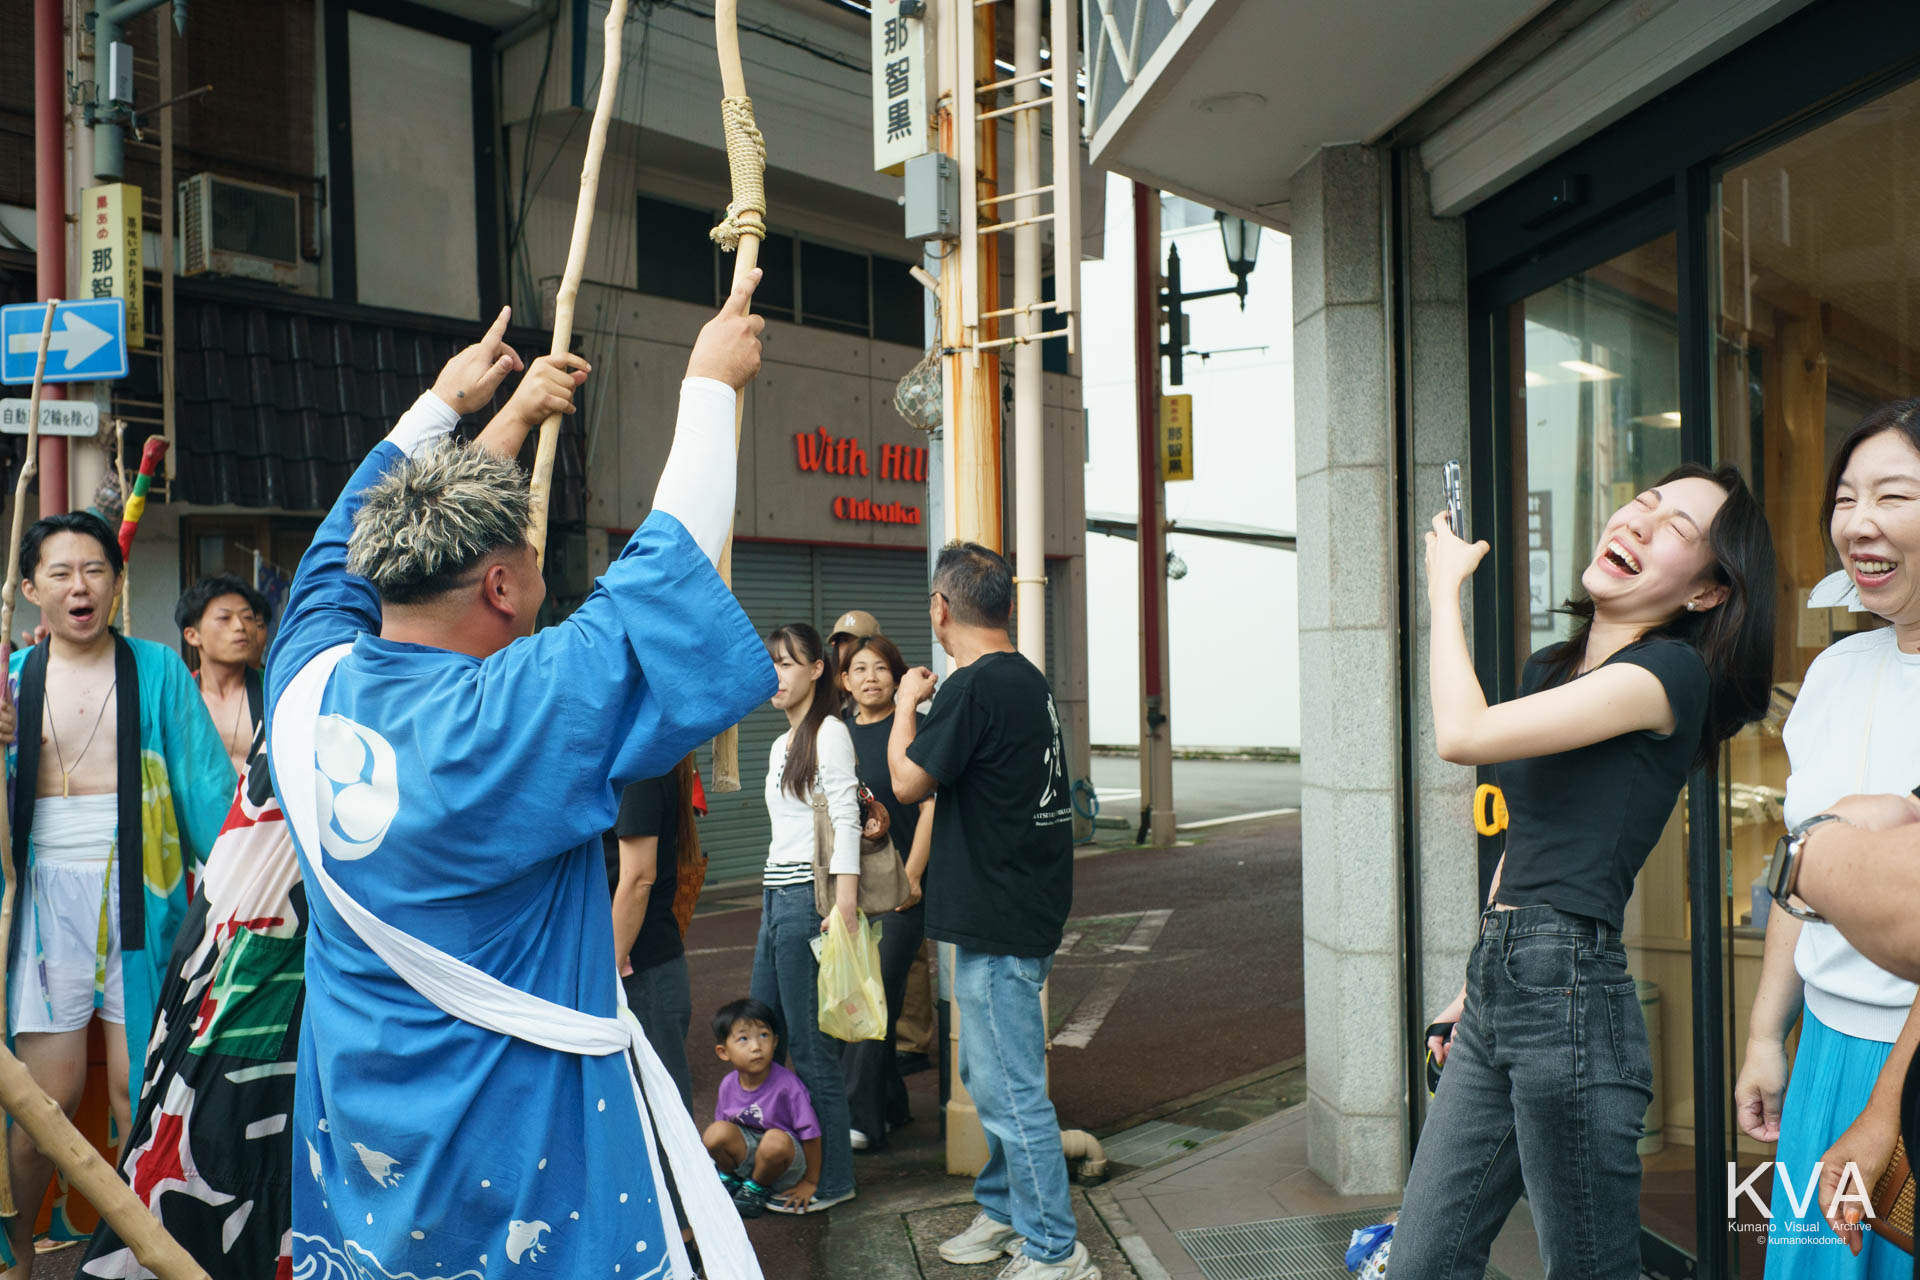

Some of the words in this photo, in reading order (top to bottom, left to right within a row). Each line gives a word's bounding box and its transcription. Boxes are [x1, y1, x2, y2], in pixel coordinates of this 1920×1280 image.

[884, 16, 911, 143] 那智黒
[3, 408, 94, 427] 自動(2輪を除く)
[796, 426, 869, 477] With
[834, 496, 921, 525] Ohtsuka
